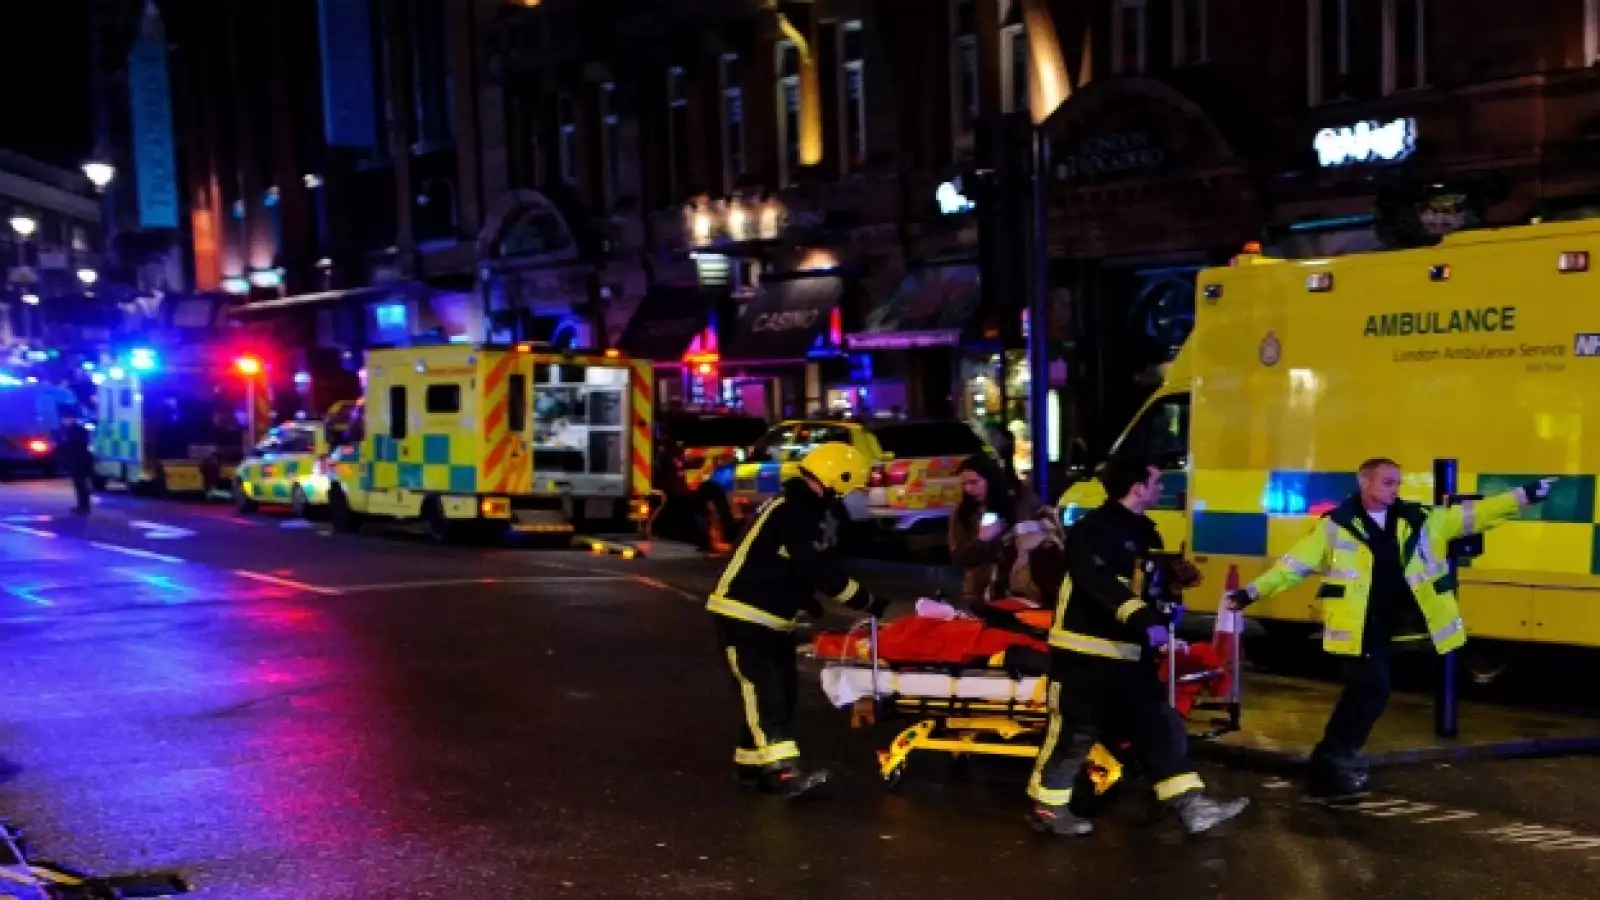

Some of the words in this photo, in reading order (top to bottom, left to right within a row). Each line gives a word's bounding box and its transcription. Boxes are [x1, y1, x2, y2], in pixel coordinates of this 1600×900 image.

[1363, 306, 1516, 337] AMBULANCE
[1393, 347, 1438, 362] London
[1444, 344, 1515, 360] Ambulance
[1520, 343, 1566, 357] Service
